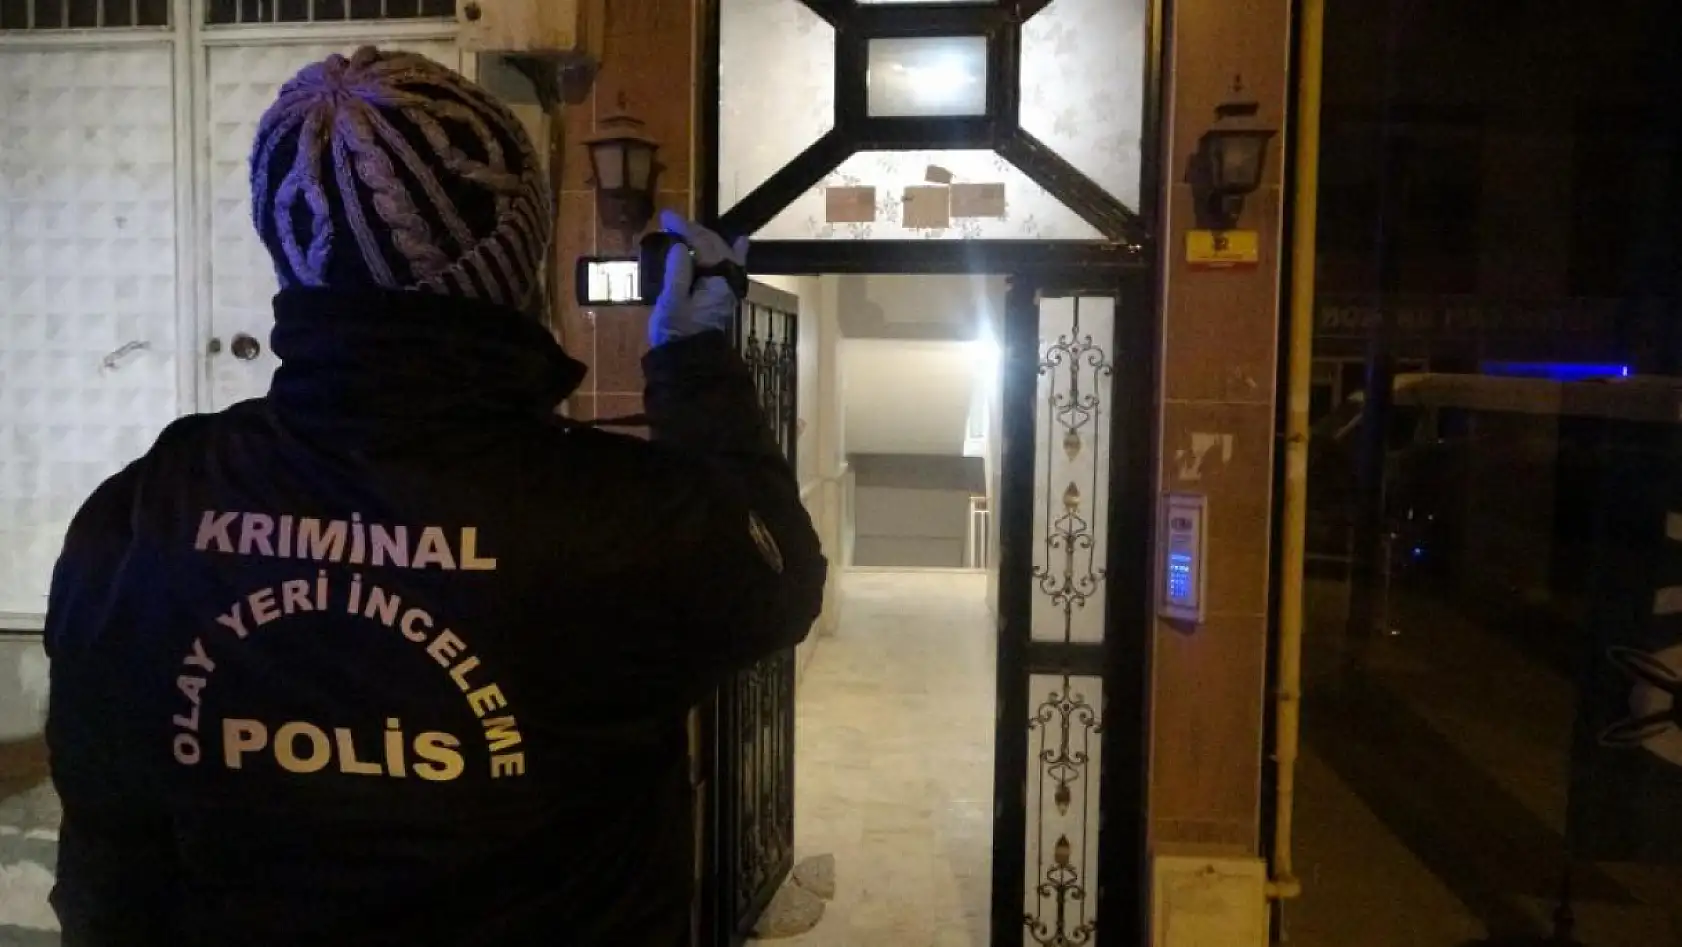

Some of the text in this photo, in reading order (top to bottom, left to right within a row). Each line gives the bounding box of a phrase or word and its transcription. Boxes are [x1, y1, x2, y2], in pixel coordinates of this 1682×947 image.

[195, 511, 498, 571] KRIMİNAL
[173, 569, 526, 780] OLAY YERİ İNCELEME
[222, 717, 466, 782] POLİS
